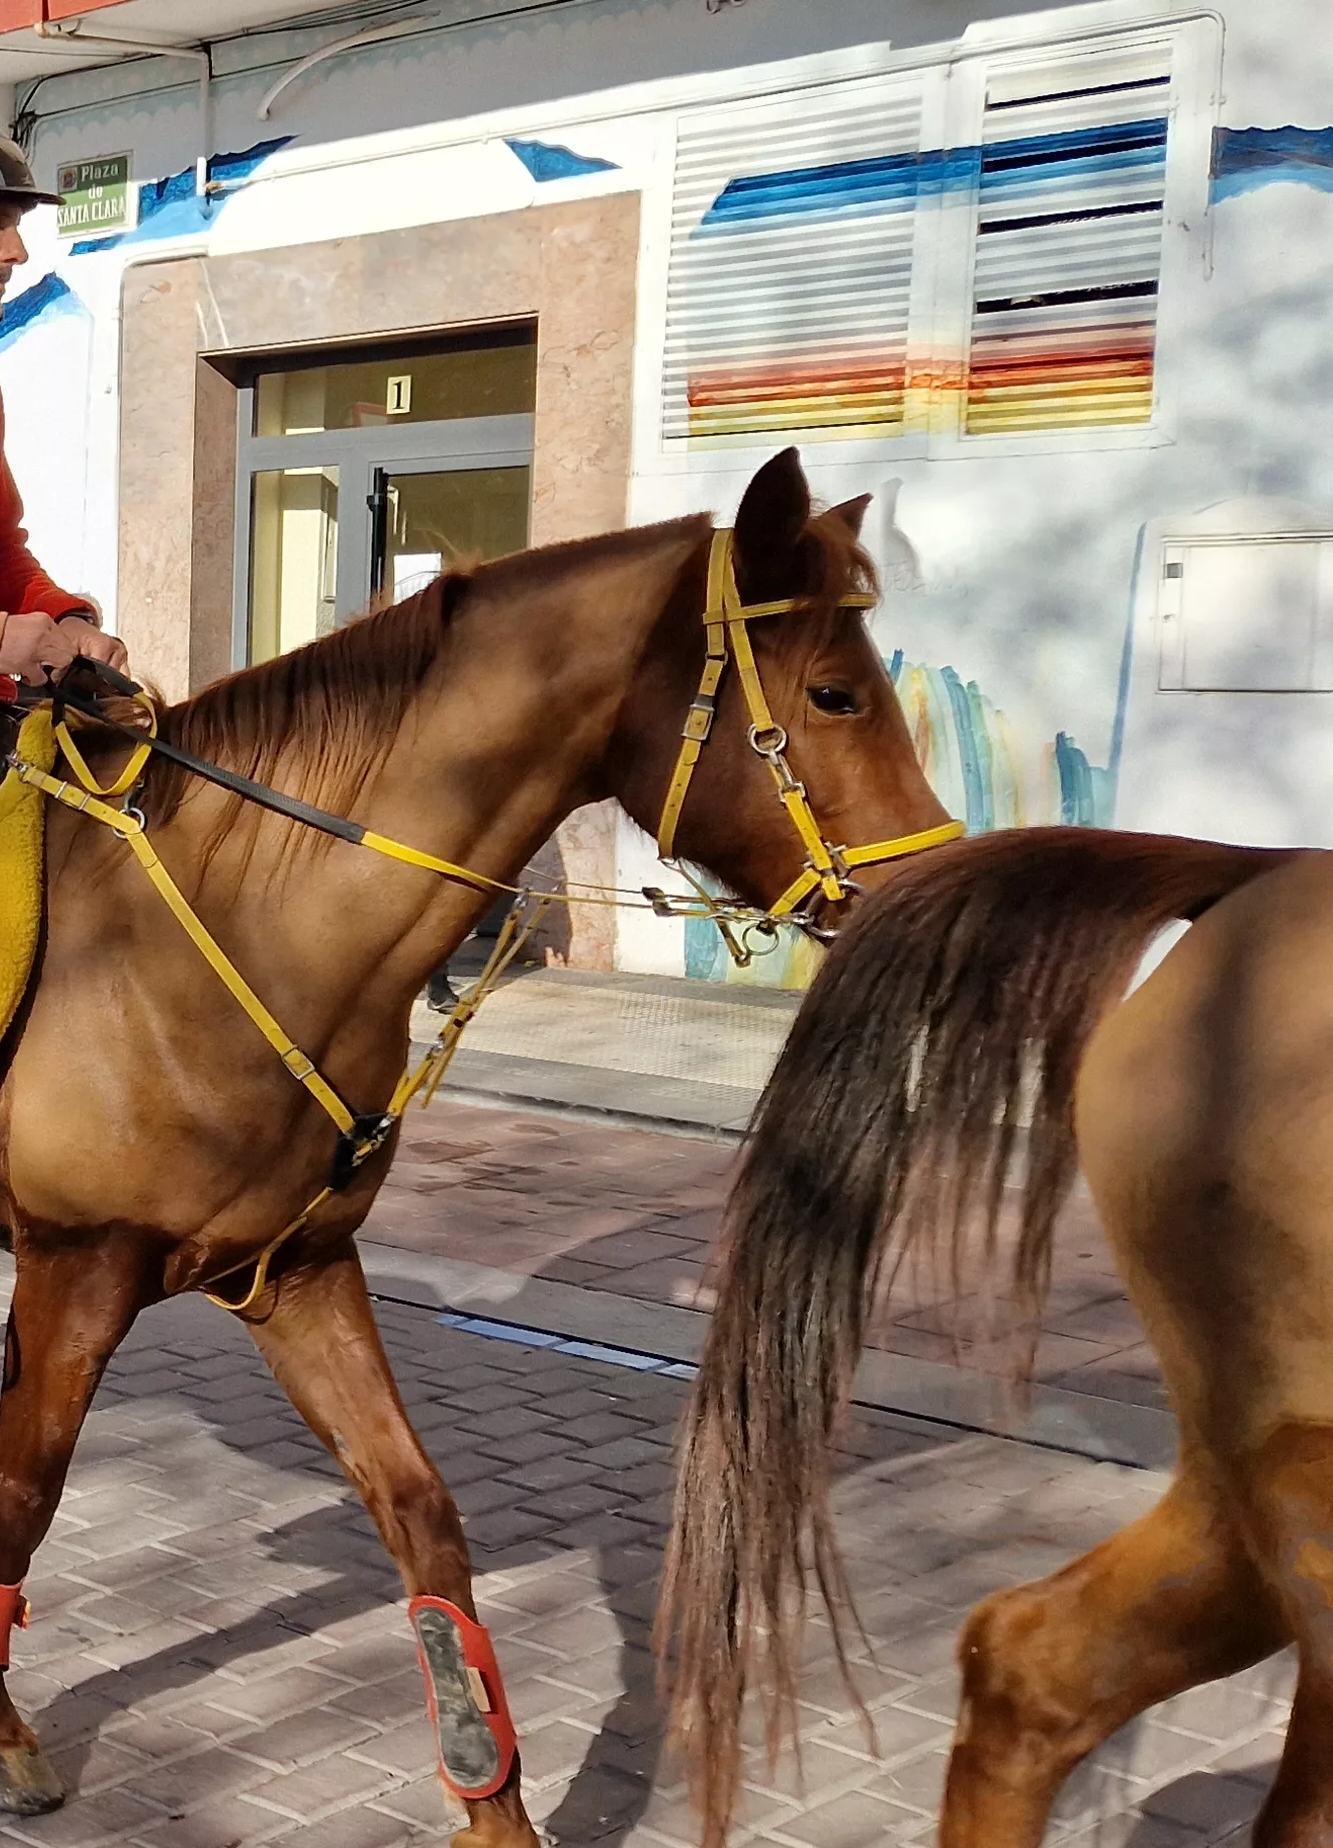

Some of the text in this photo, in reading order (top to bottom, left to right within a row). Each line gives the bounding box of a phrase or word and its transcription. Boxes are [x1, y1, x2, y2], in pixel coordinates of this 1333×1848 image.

[81, 164, 118, 182] Plaza
[88, 184, 103, 199] de
[58, 196, 125, 226] SANTA CLARA
[392, 381, 405, 409] 1
